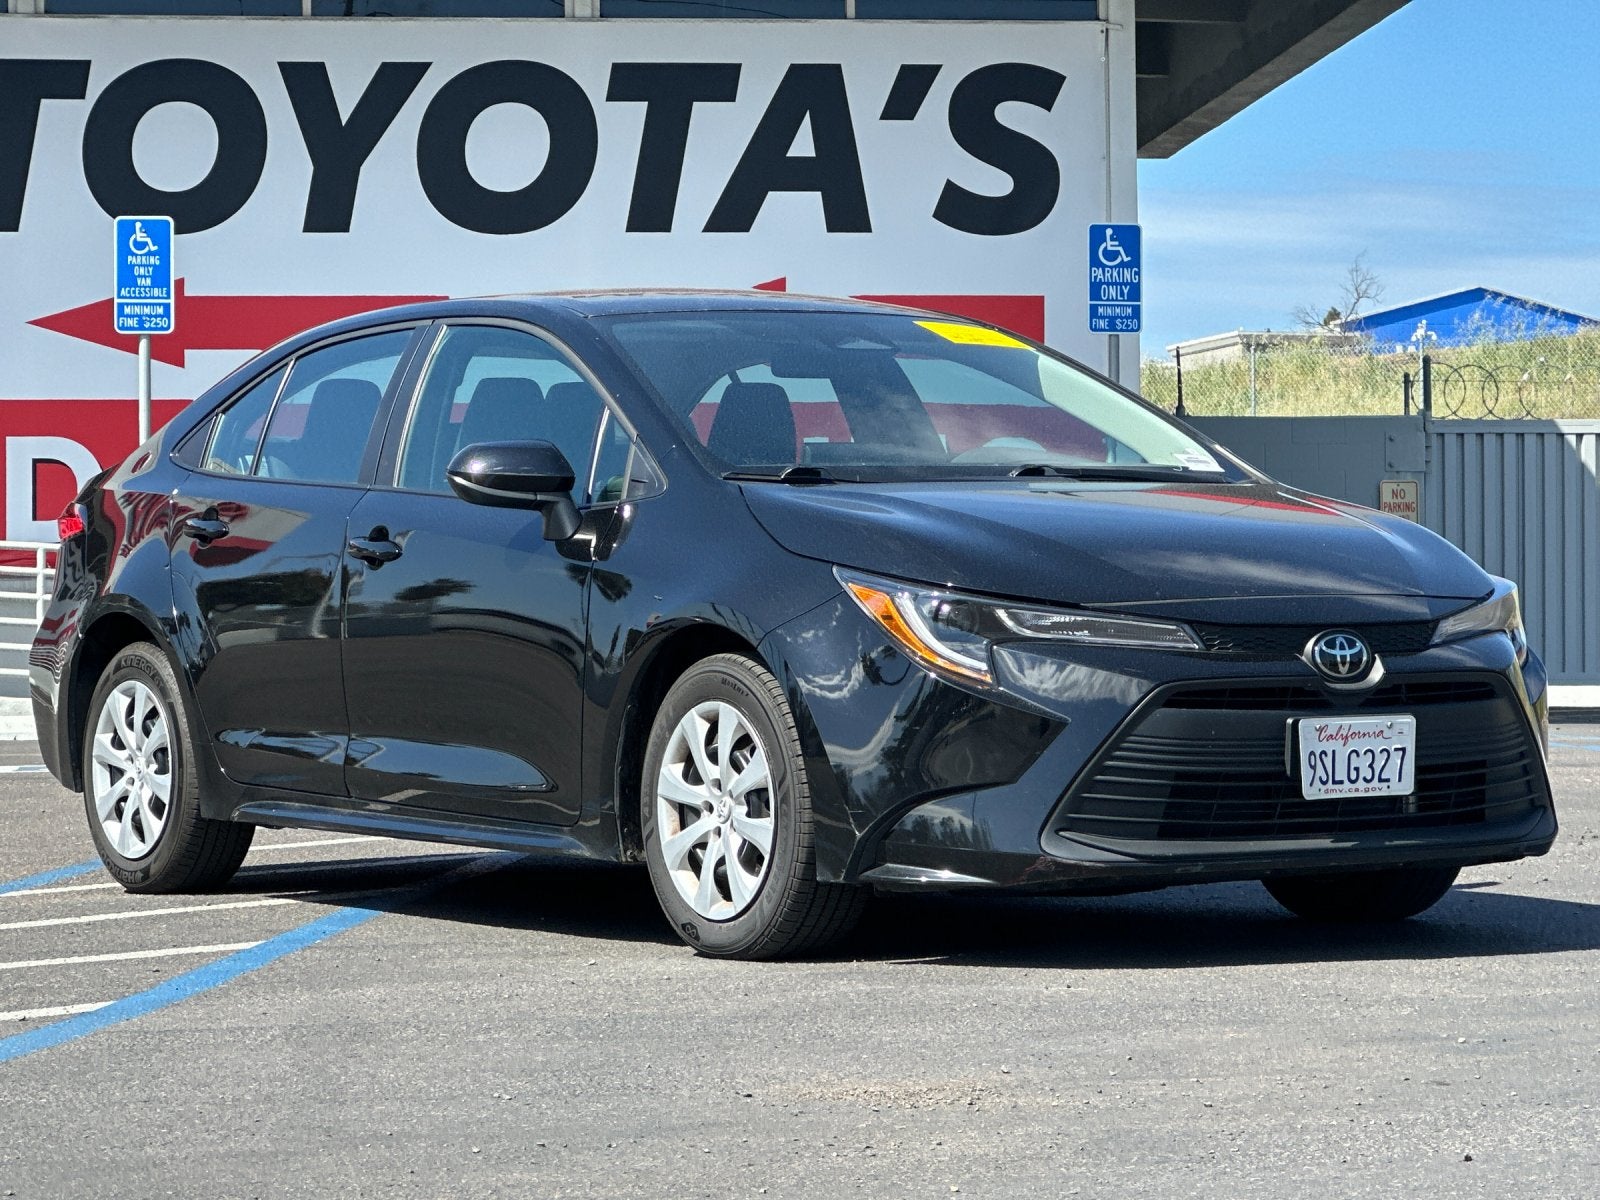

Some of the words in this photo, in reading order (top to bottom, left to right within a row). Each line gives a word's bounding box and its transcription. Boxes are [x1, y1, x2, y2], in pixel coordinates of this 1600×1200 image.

[0, 58, 1067, 235] TOYOTA'S
[127, 255, 160, 265] PARKING
[134, 266, 153, 276] ONLY
[1091, 267, 1139, 283] PARKING
[136, 277, 151, 287] VAN
[120, 287, 167, 297] ACCESSIBLE
[1100, 284, 1130, 300] ONLY
[124, 305, 164, 315] MINIMUM
[1097, 305, 1132, 317] MINIMUM
[119, 317, 139, 328] FINE
[142, 316, 168, 328] $250
[1092, 318, 1109, 329] FINE
[1115, 318, 1138, 330] $250
[1391, 488, 1406, 500] NO
[1383, 501, 1416, 513] PARKING
[1318, 724, 1392, 747] California
[1308, 746, 1407, 788] 9SLG327
[1324, 786, 1384, 794] dmv.ca.gov
